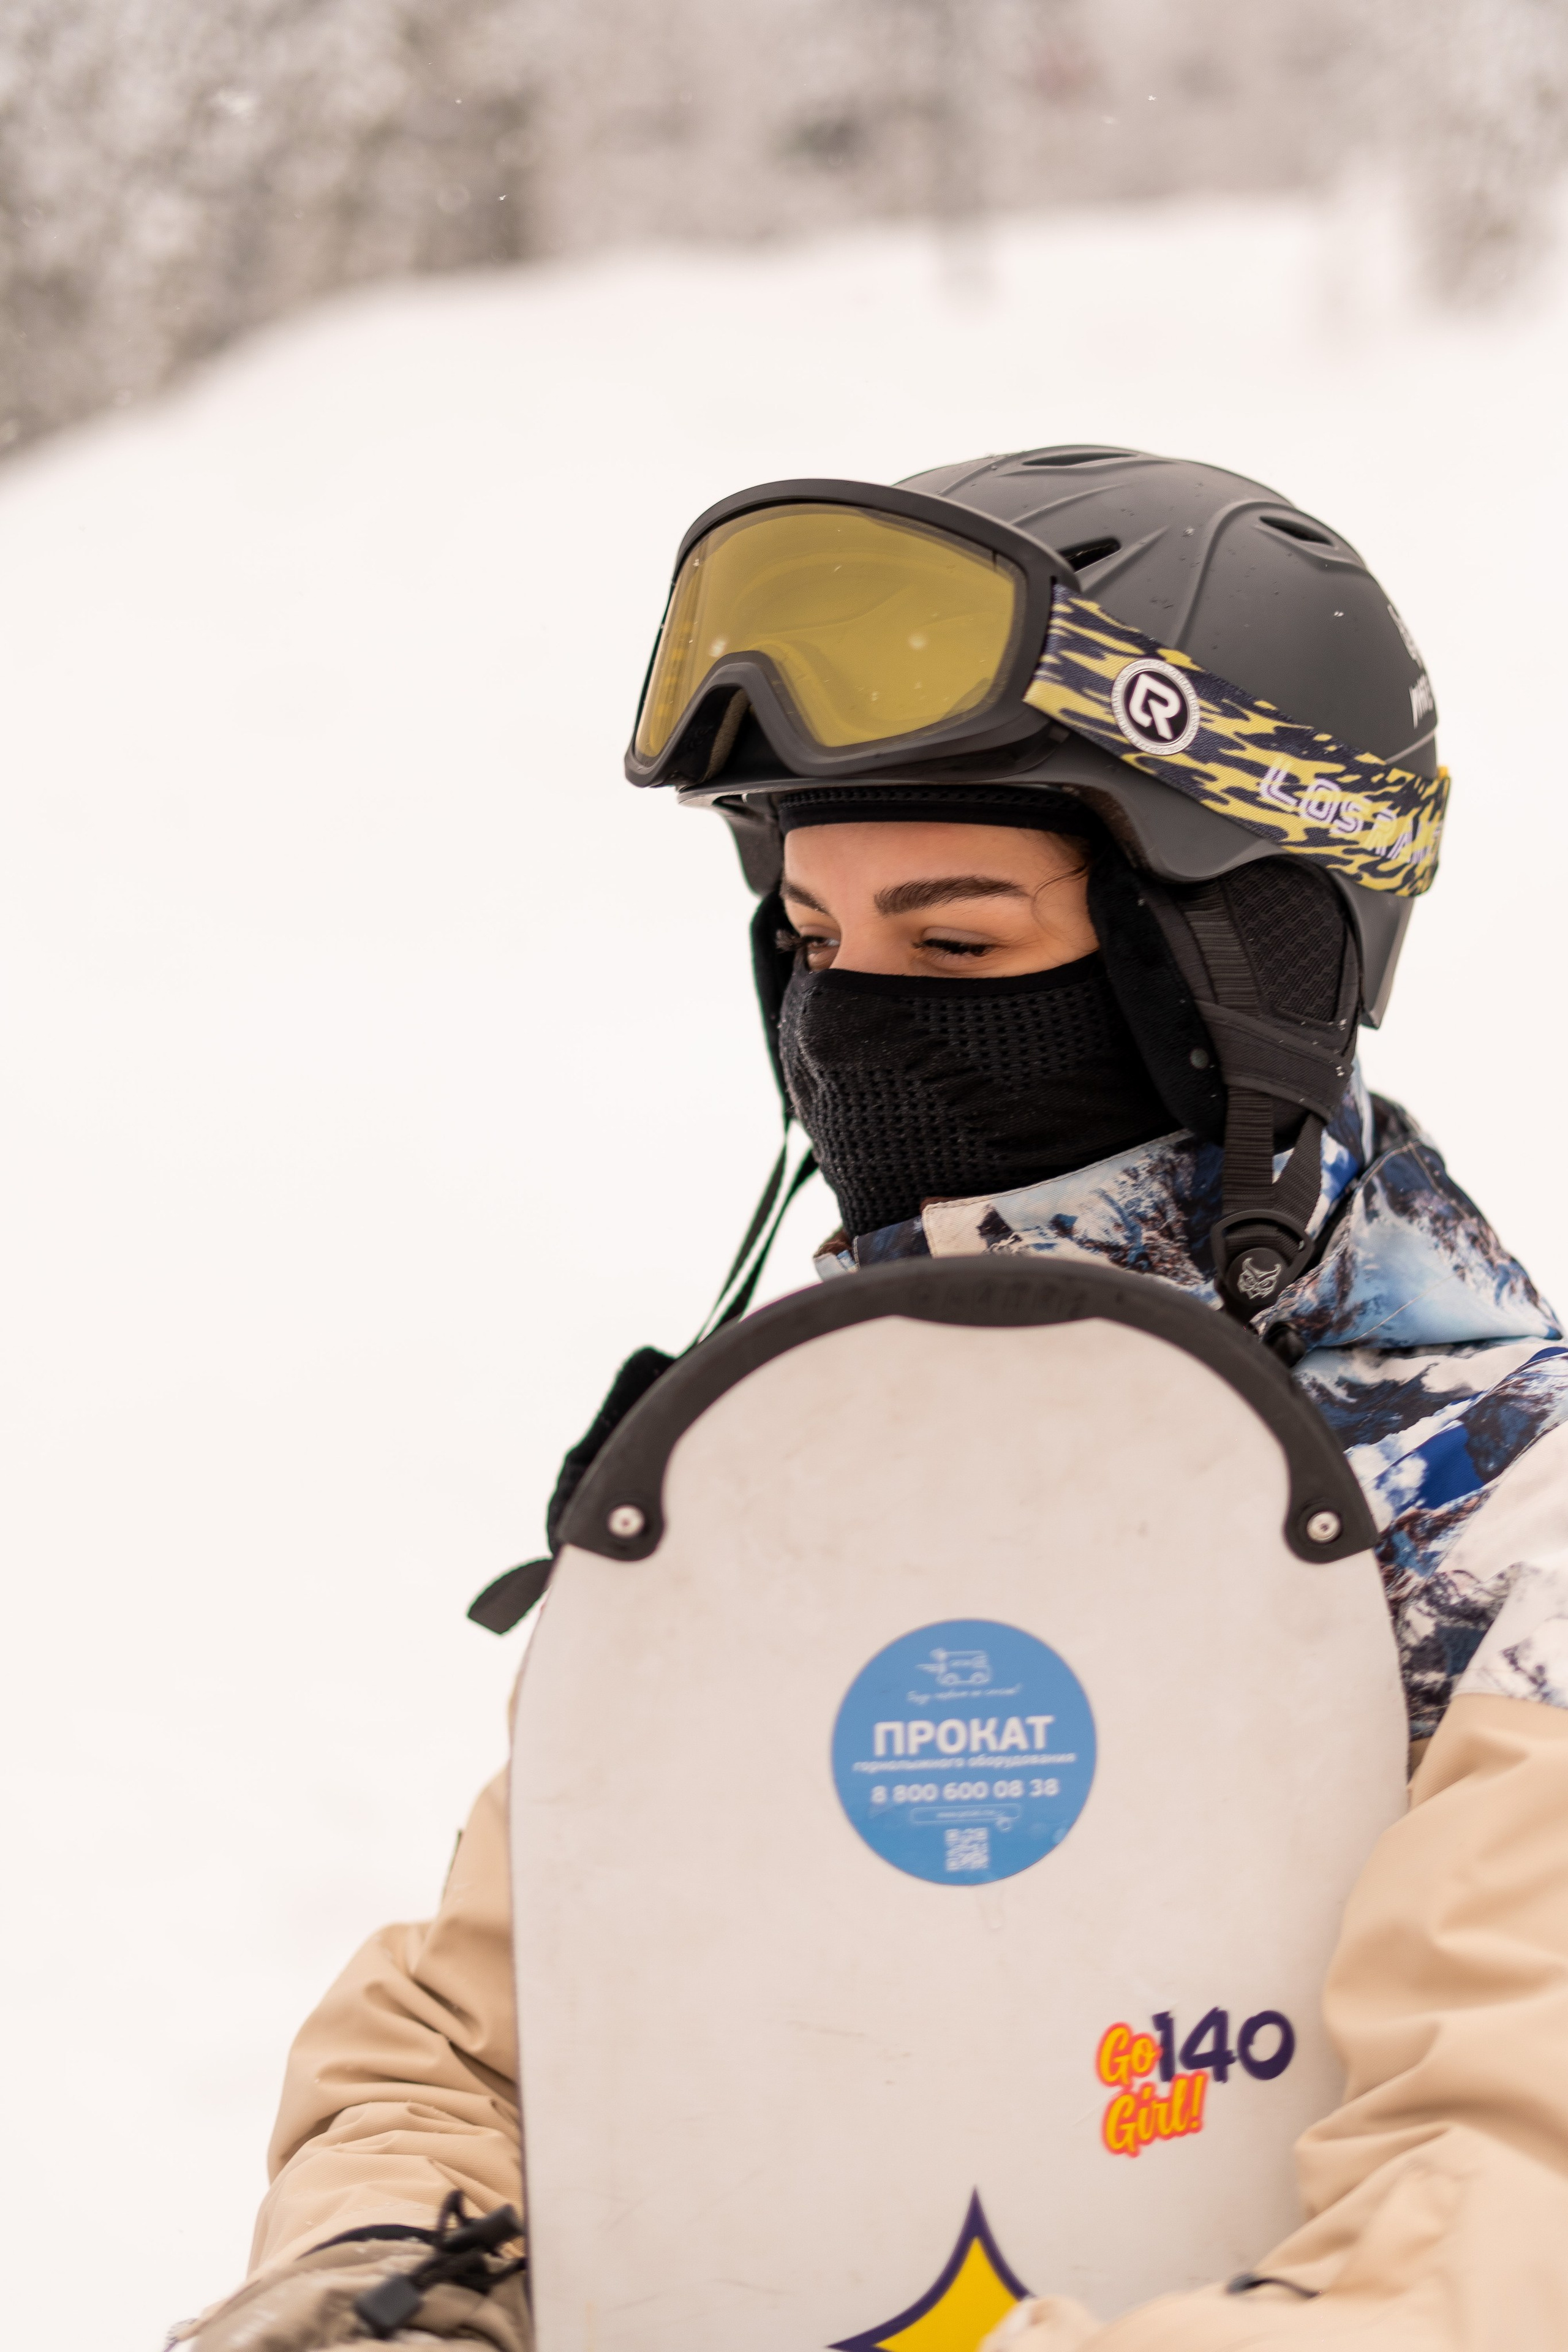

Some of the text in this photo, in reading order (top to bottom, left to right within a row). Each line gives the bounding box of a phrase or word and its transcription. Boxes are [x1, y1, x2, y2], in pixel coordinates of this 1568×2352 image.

[874, 1715, 1055, 1756] ПРОКАТ
[872, 1777, 1059, 1804] 8 800 600 08 38
[1096, 2022, 1163, 2087] Go
[1152, 2007, 1295, 2083] 140
[1101, 2070, 1209, 2158] Girl!
